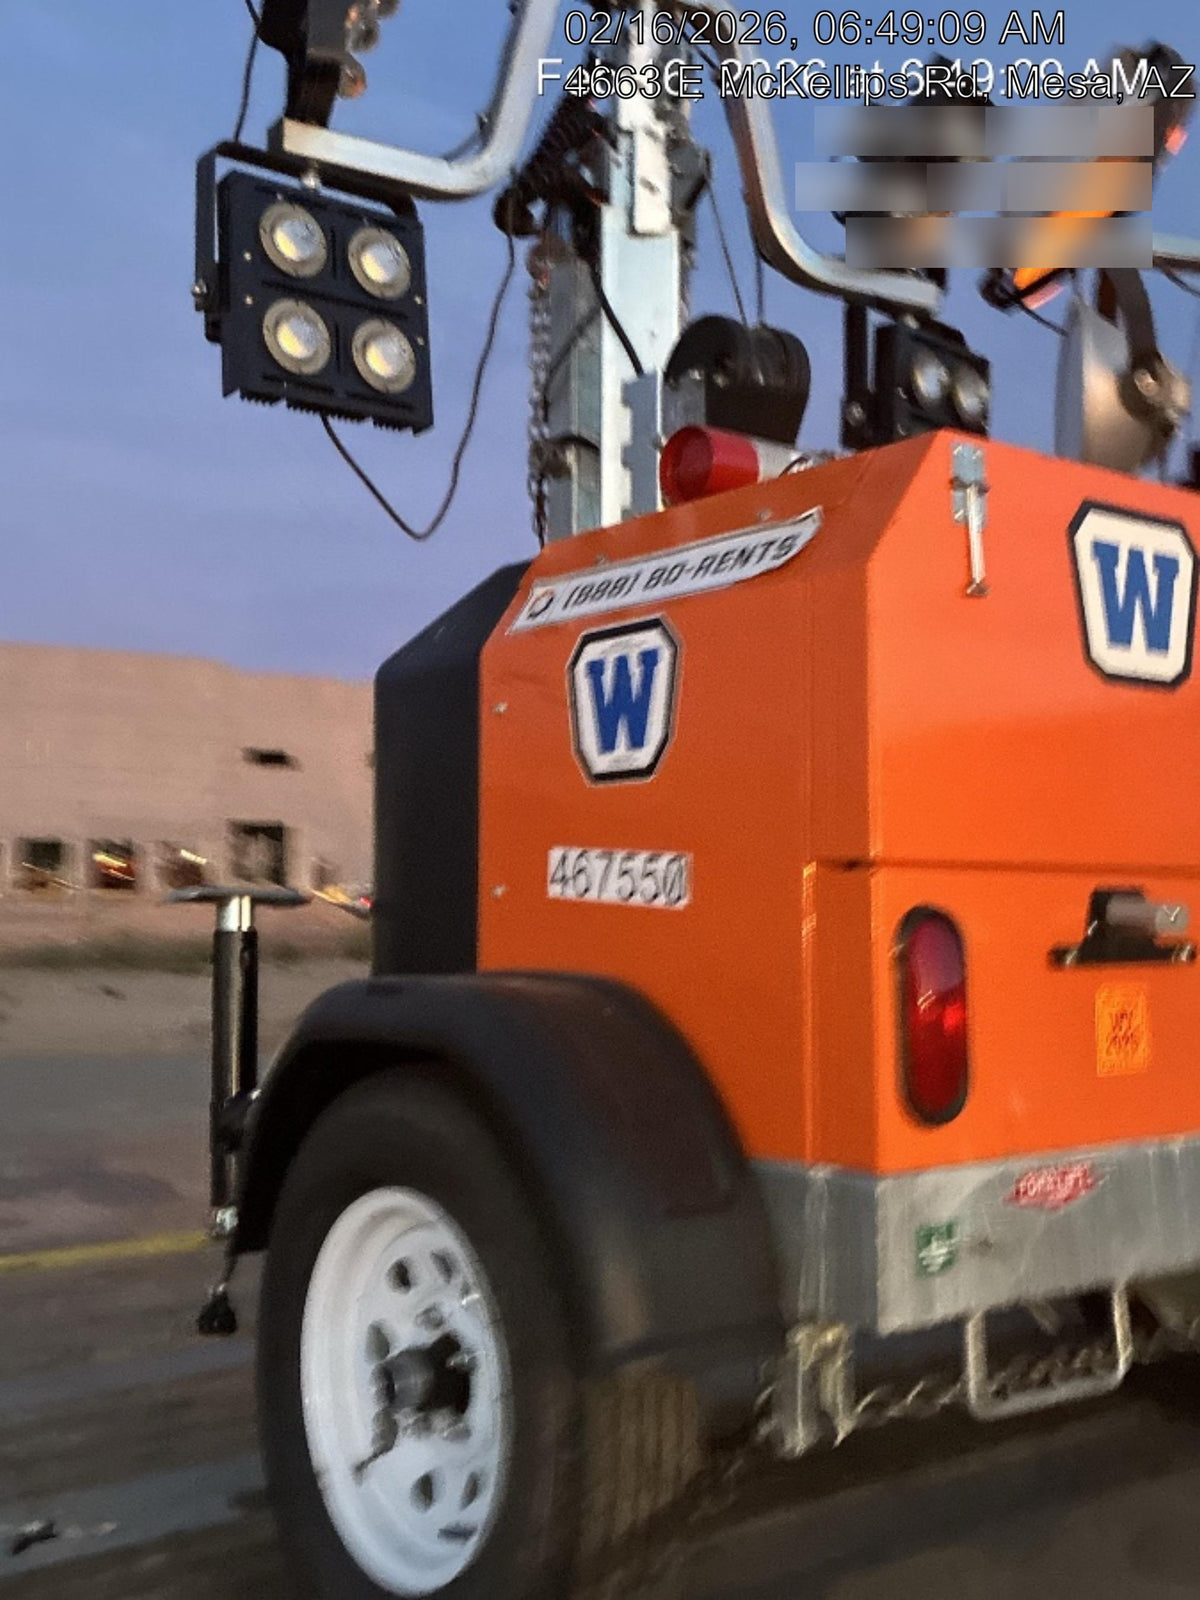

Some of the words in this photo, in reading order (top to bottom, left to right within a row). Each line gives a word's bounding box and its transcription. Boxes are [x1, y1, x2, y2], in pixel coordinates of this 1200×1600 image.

[562, 573, 641, 610] (888)
[643, 531, 802, 593] 80-RENTS
[1091, 540, 1180, 657] W
[585, 647, 661, 756] W
[550, 849, 686, 906] 467550
